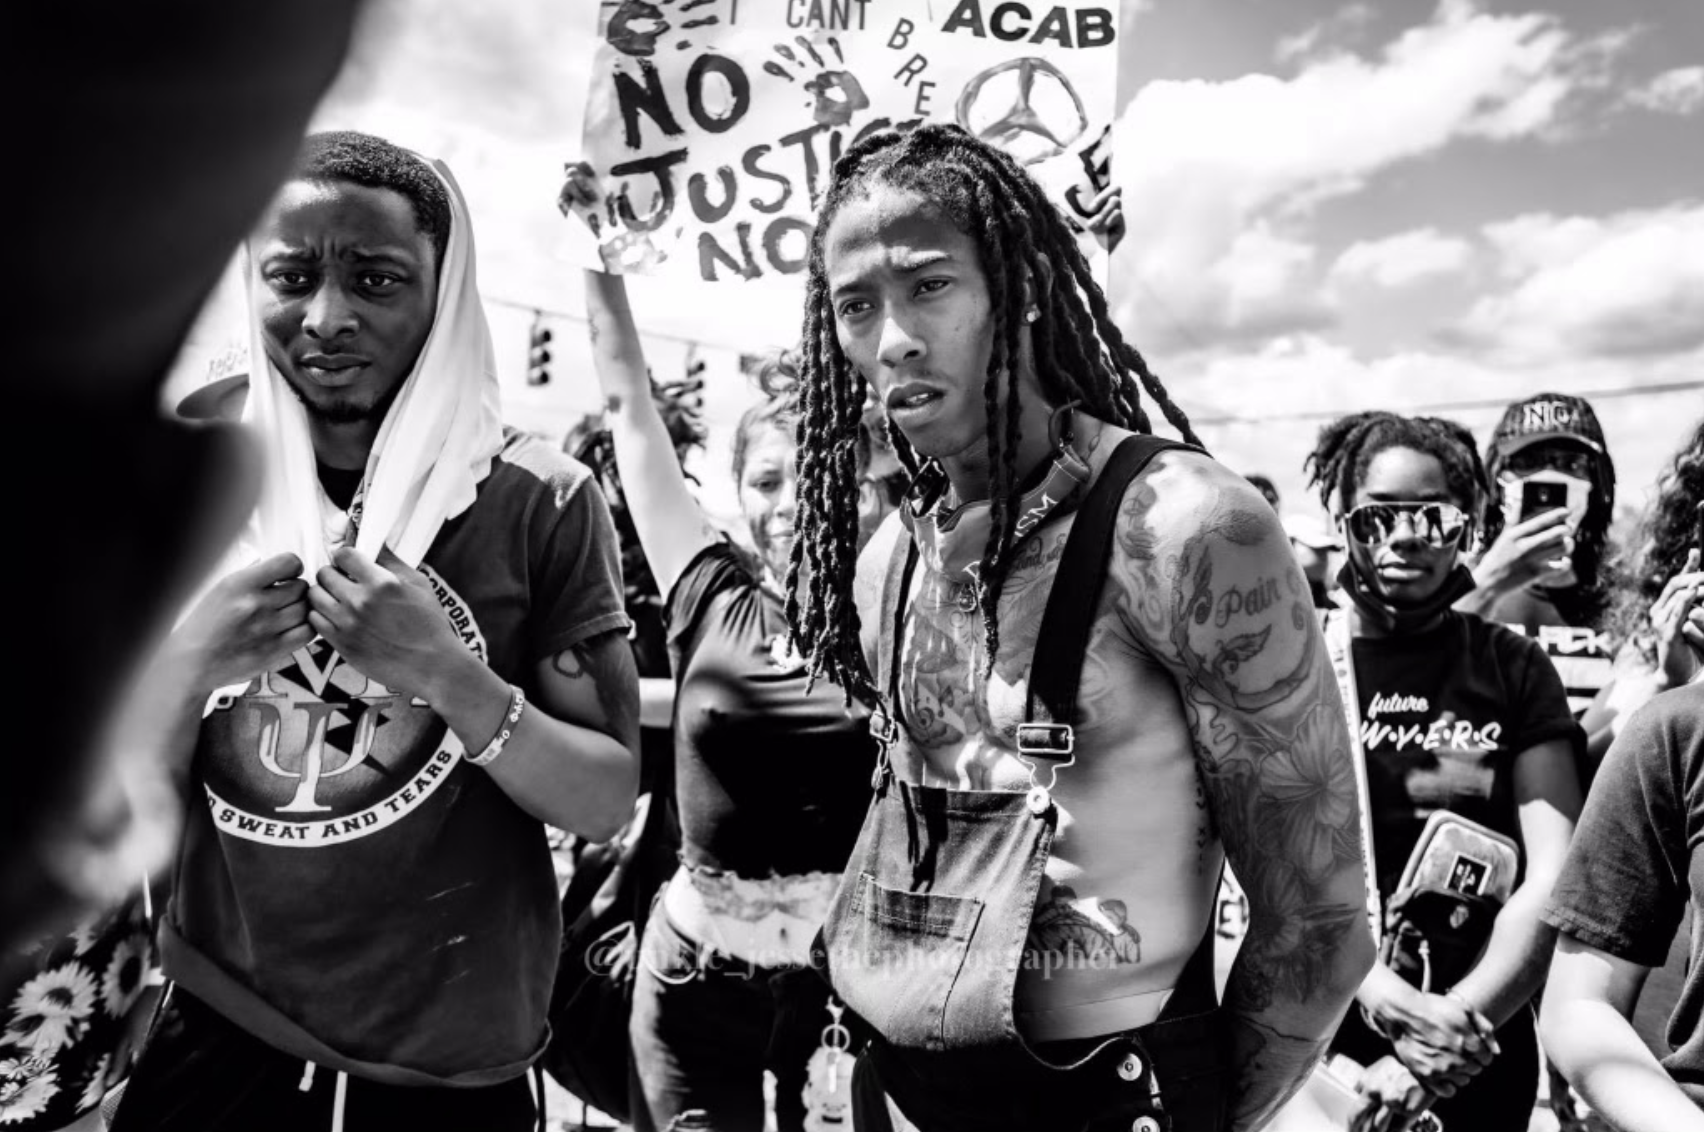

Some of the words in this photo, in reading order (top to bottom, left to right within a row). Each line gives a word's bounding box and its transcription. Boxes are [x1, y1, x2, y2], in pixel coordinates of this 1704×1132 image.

[786, 0, 872, 30] CANT
[941, 2, 1115, 48] ACAB
[611, 53, 750, 150] NO
[610, 117, 924, 232] JUSTI
[698, 217, 814, 282] NO
[1367, 691, 1430, 720] future
[219, 808, 310, 840] SWEAT
[322, 811, 379, 838] AND
[384, 750, 452, 813] TEARS
